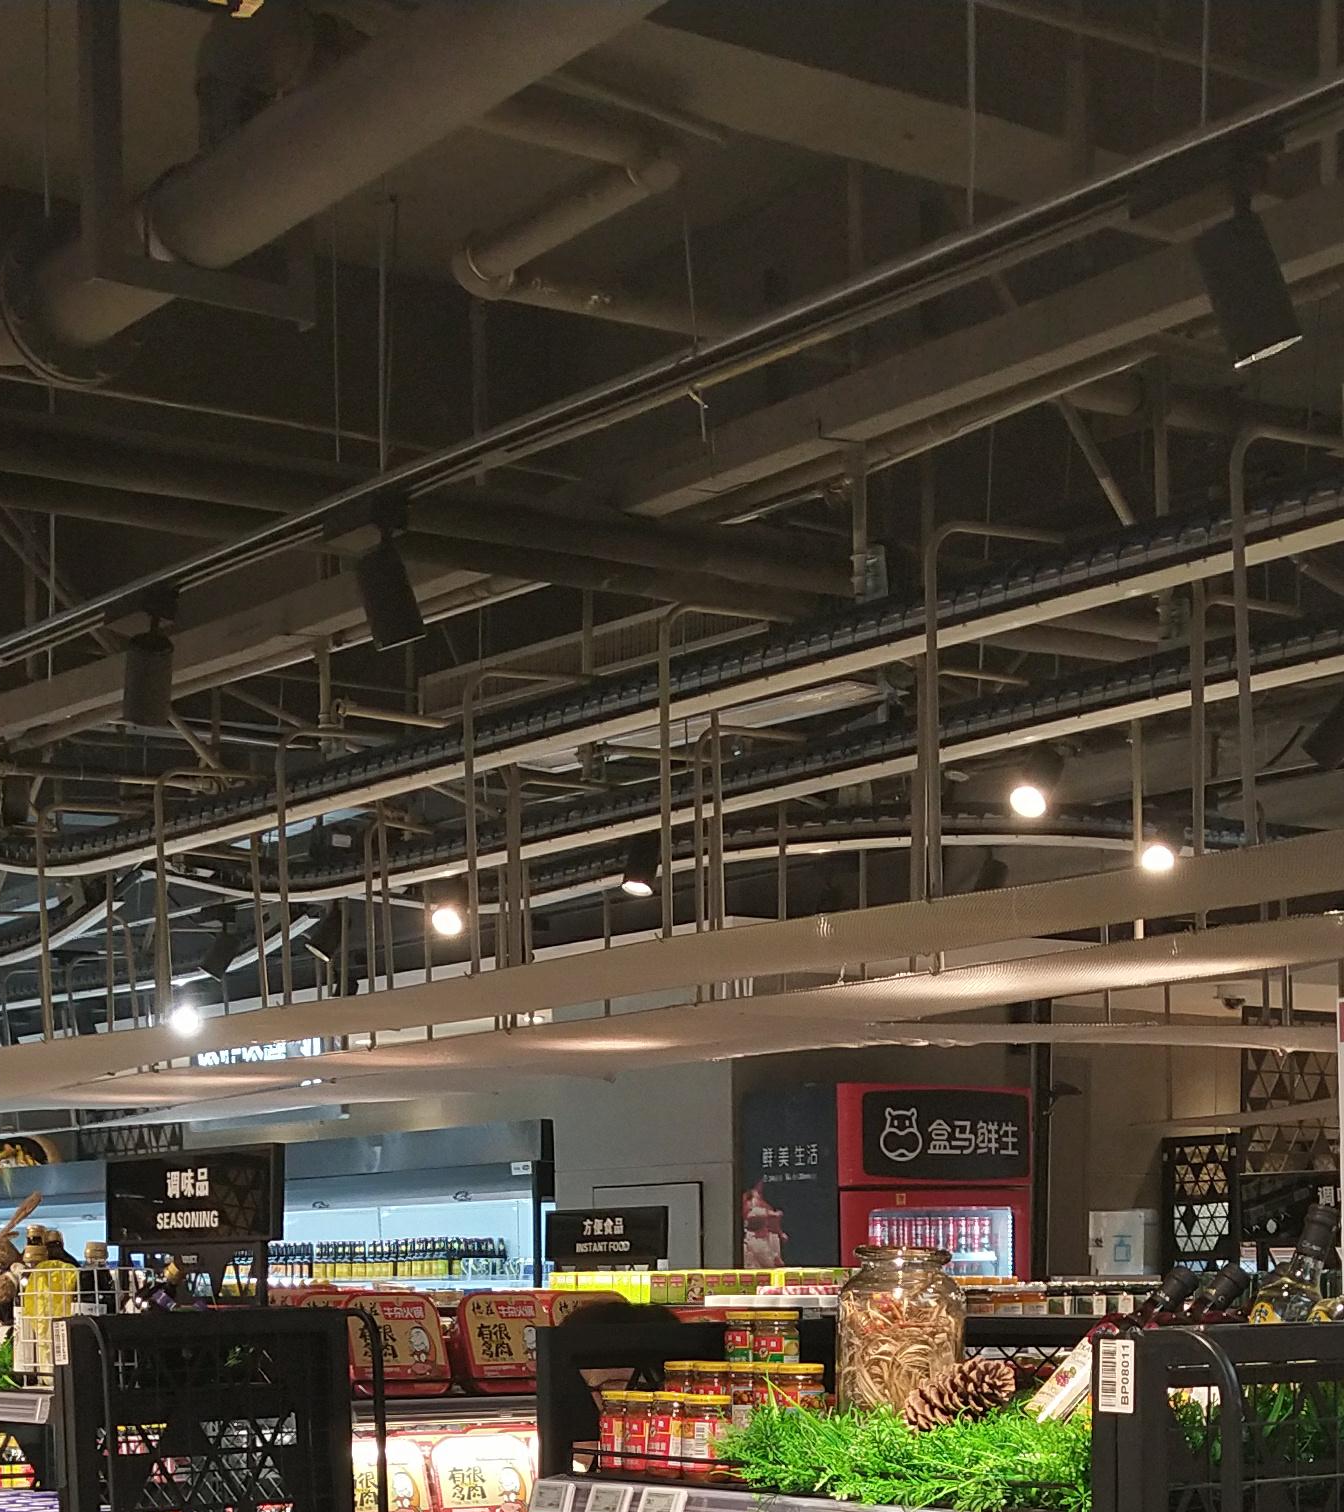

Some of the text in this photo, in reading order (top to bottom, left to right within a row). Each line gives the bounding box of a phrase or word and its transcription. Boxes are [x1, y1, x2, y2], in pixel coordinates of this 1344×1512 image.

[927, 1118, 1019, 1156] 盒马鲜生
[762, 1143, 818, 1168] 鲜美生活
[166, 1167, 210, 1199] 调味品
[156, 1210, 220, 1230] SEASONING
[582, 1217, 624, 1236] 方便食品
[575, 1241, 631, 1253] INSTANT FOOD
[1120, 1344, 1130, 1406] BP08011
[448, 1467, 486, 1483] 有很
